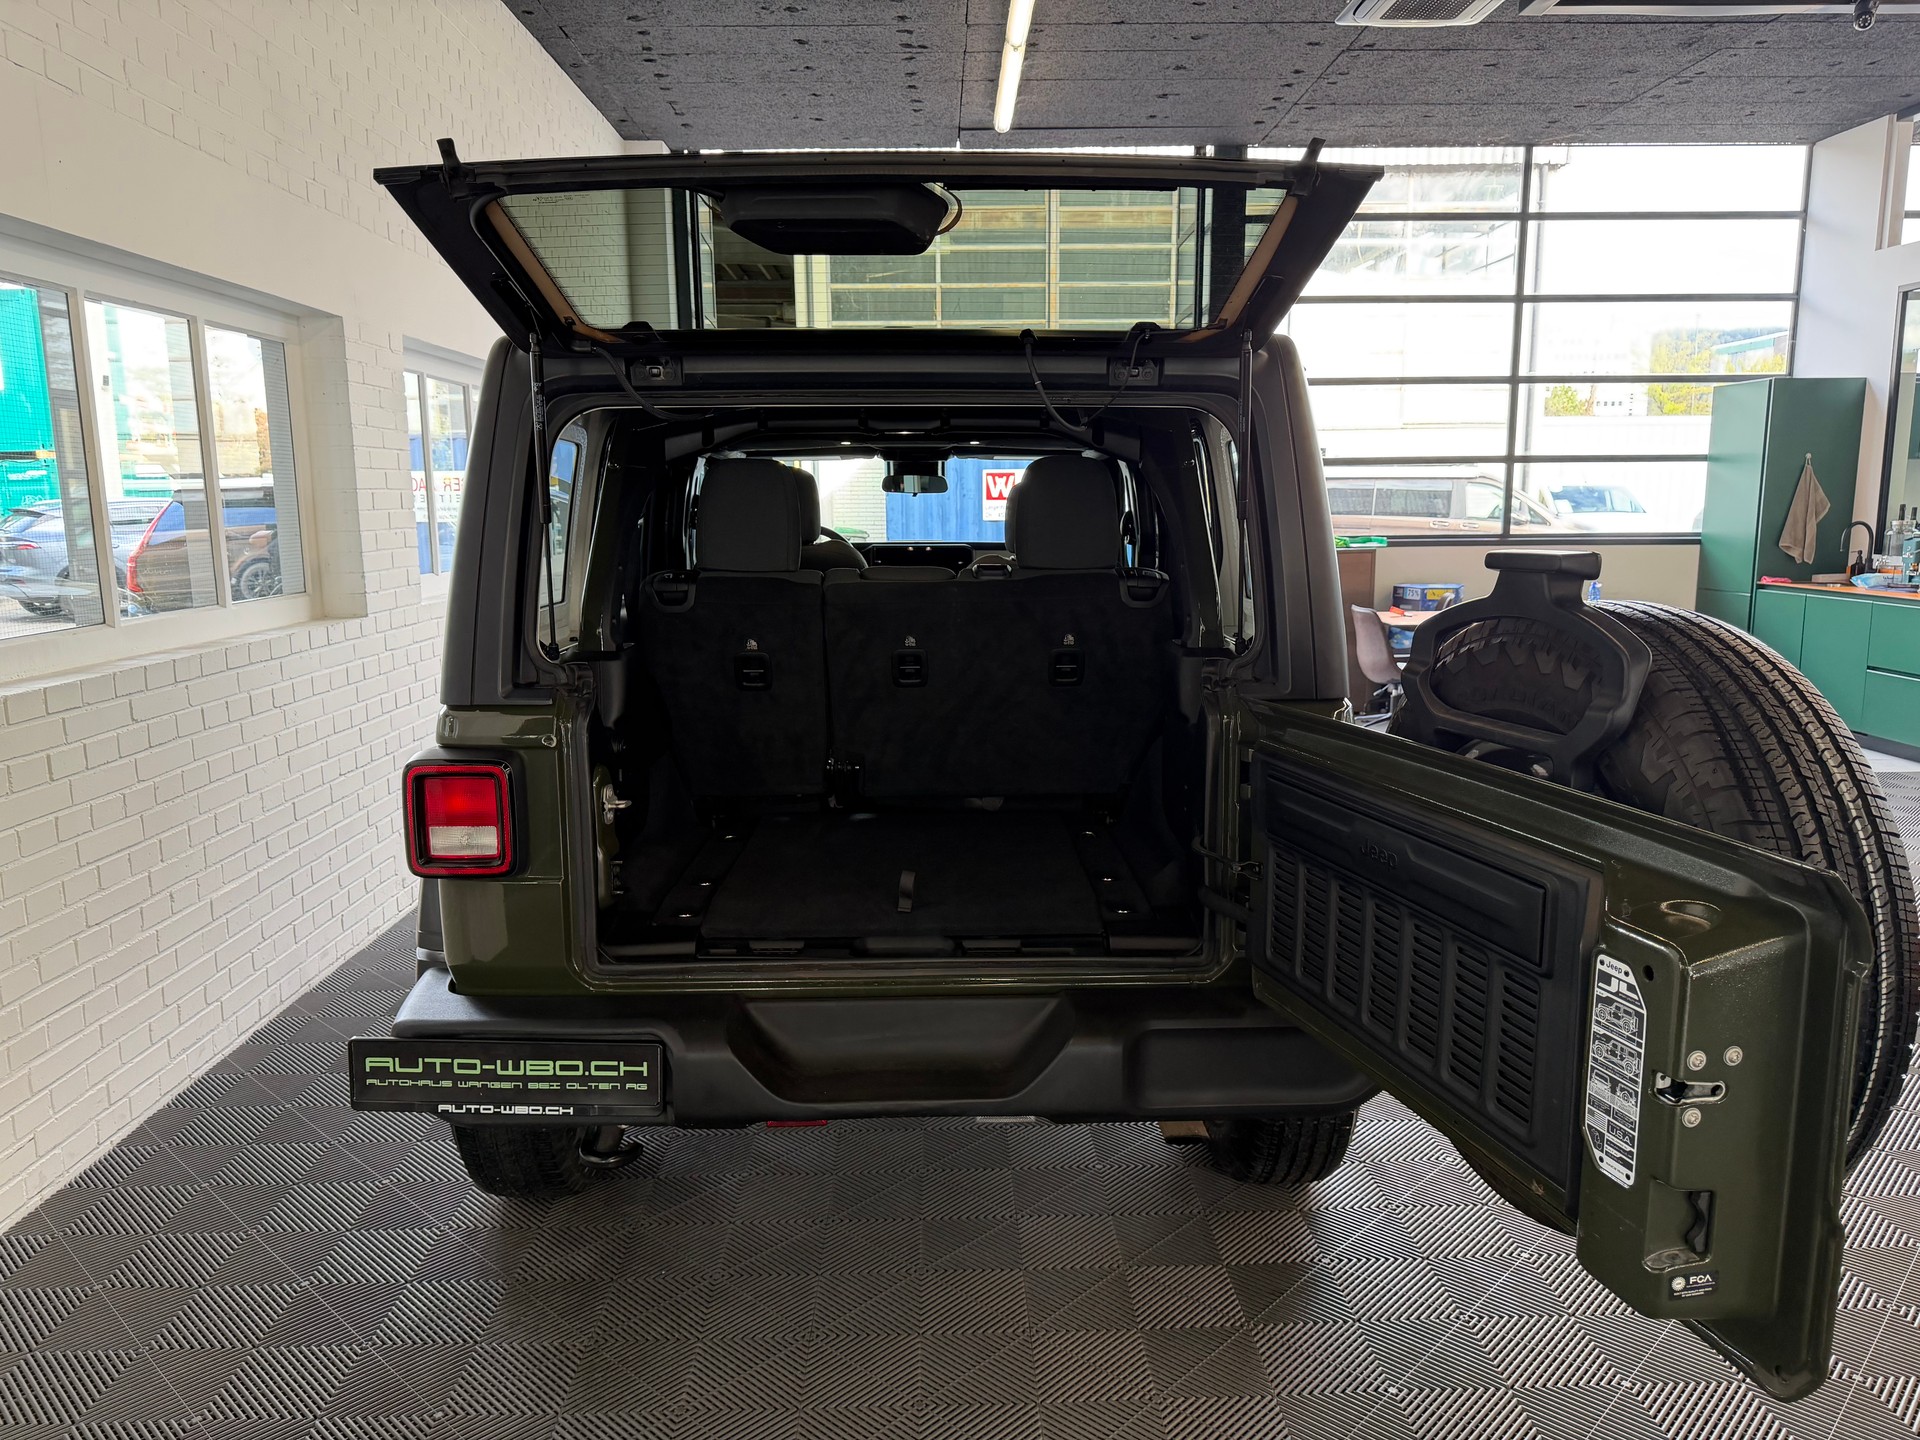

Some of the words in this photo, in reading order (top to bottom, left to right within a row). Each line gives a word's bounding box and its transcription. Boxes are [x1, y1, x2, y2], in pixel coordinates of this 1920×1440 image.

[1361, 838, 1398, 868] Jeep
[1606, 961, 1623, 974] Jeep
[1598, 976, 1639, 1000] JL
[365, 1057, 648, 1077] AUTO-WBO.CH
[366, 1078, 453, 1088] AUTOHAUS
[457, 1080, 523, 1089] WANGEN
[528, 1082, 561, 1090] BEI
[566, 1082, 621, 1091] OLTEN
[626, 1083, 648, 1091] AG
[438, 1104, 574, 1116] AUTO-WBO.CH
[1689, 1274, 1713, 1285] FCA
